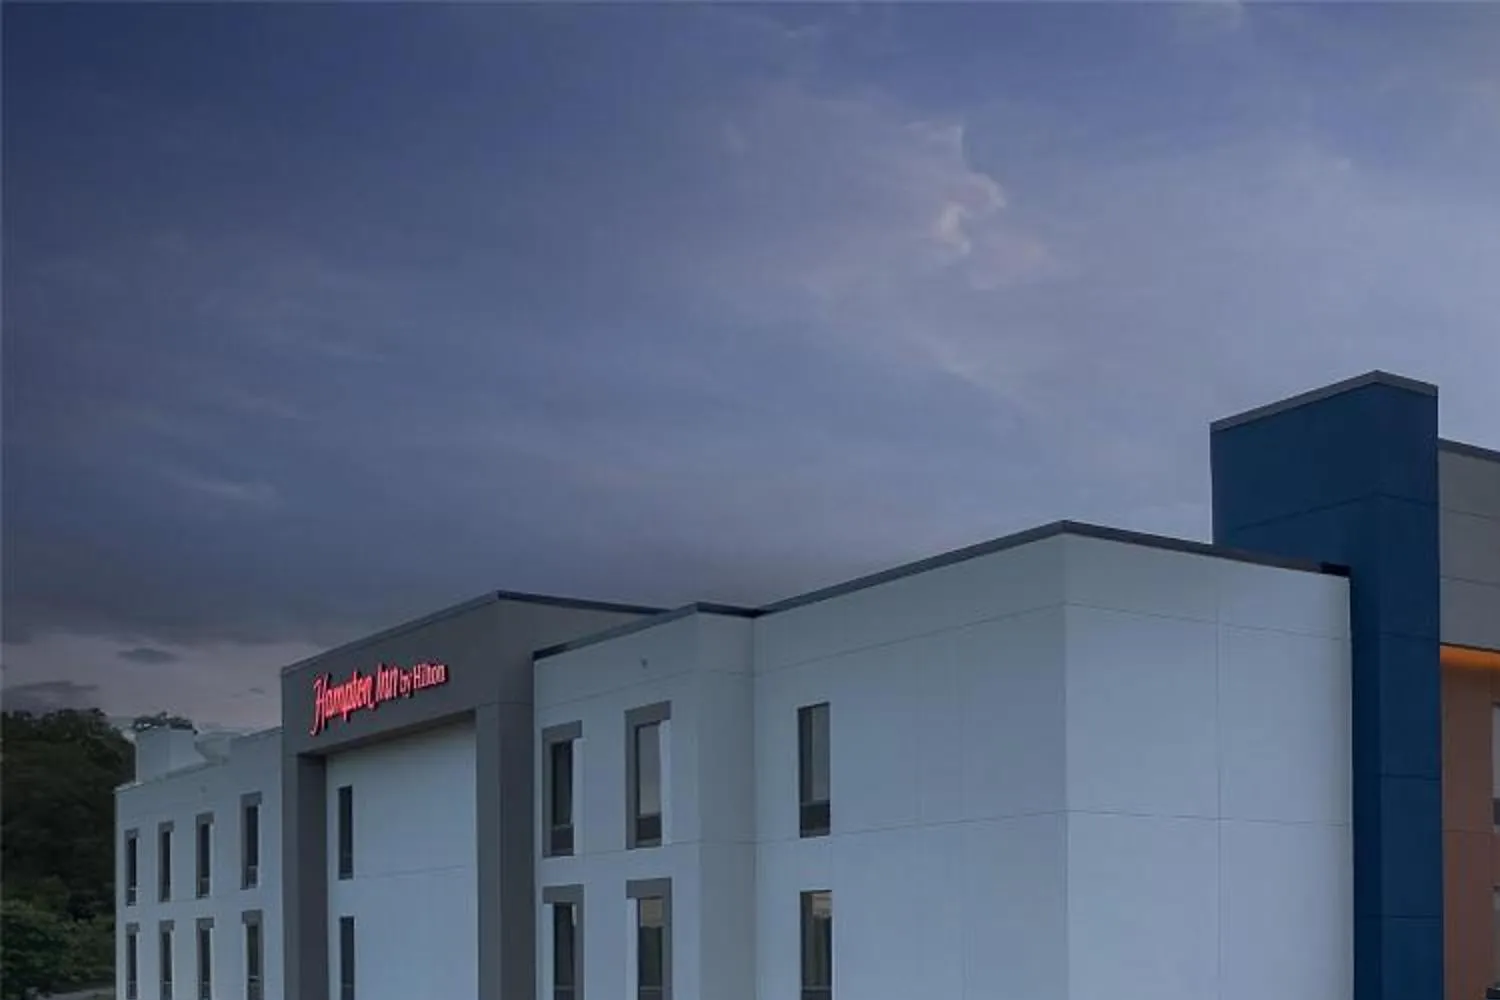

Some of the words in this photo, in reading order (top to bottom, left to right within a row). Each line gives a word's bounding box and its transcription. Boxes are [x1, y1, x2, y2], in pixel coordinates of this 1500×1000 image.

[309, 671, 375, 736] Hampton
[376, 661, 398, 702] Inn
[399, 668, 412, 699] by
[413, 661, 446, 690] Hilton
